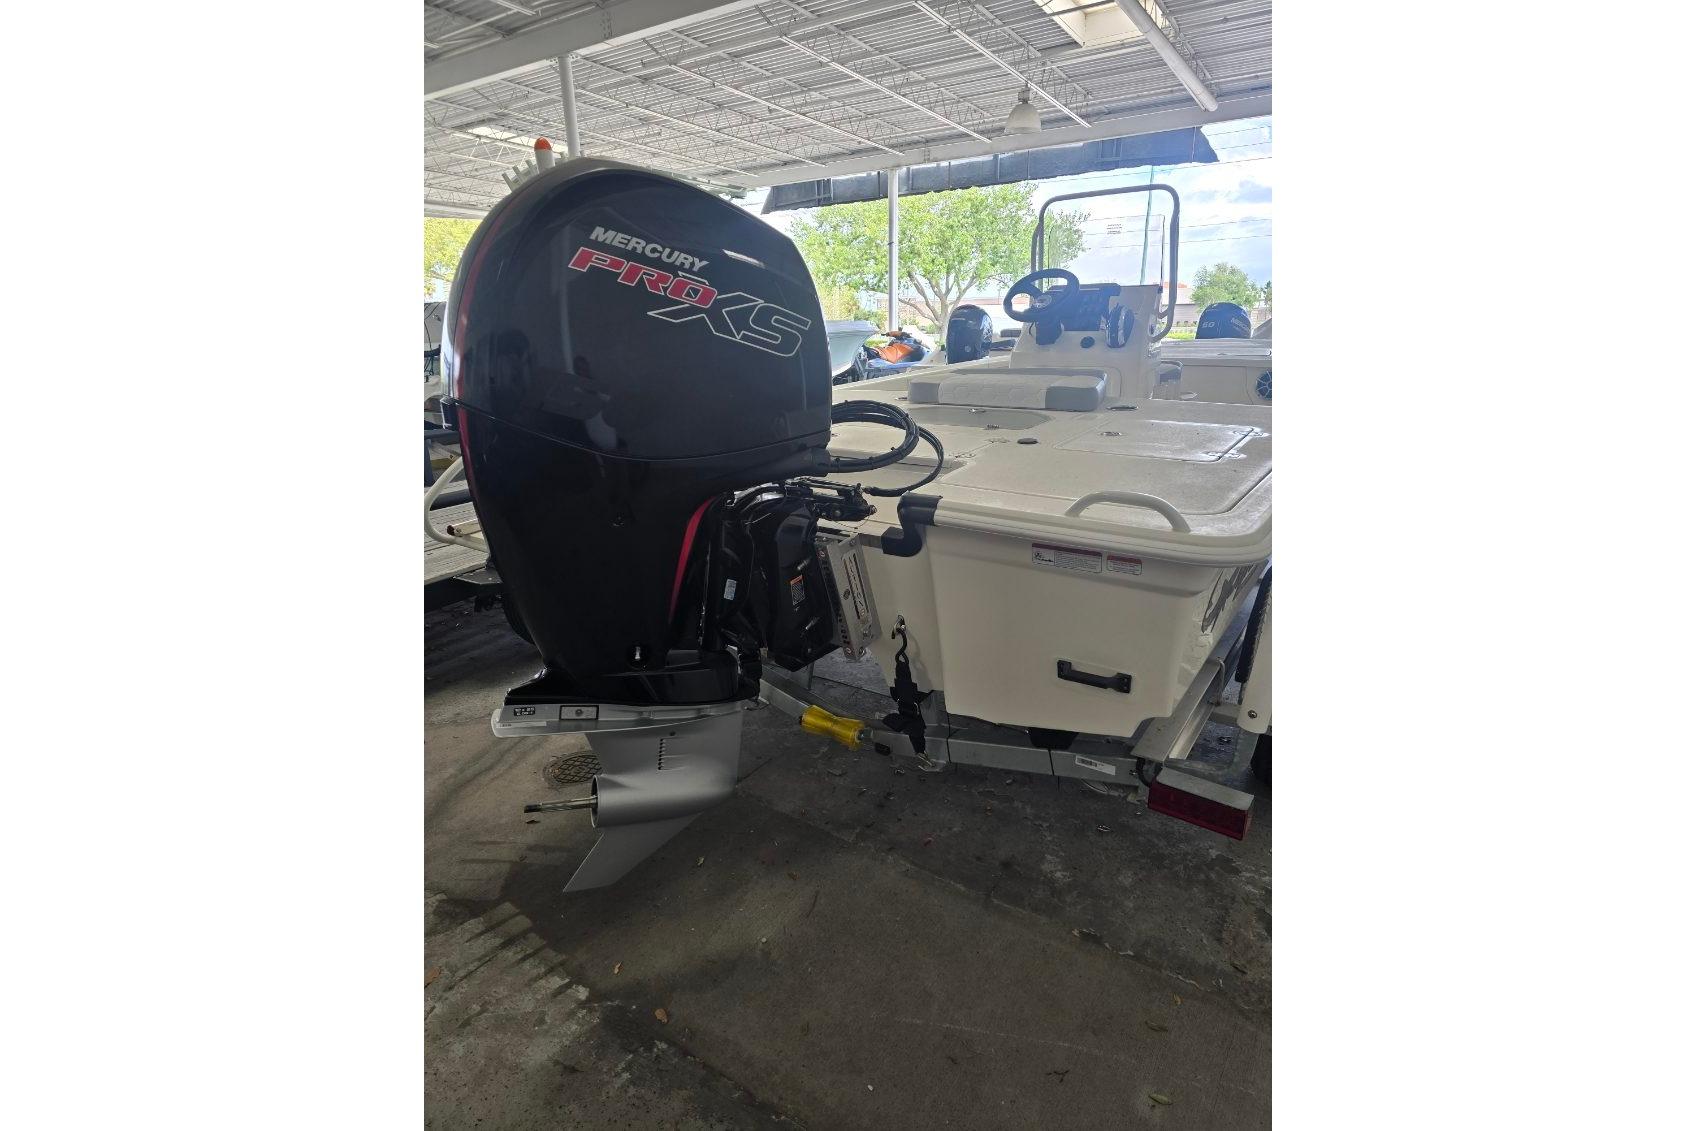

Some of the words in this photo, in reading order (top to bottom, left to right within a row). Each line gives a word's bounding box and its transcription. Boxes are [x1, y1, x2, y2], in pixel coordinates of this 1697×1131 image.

[589, 226, 709, 272] MERCURY
[568, 246, 717, 308] PRO
[647, 291, 811, 356] XS
